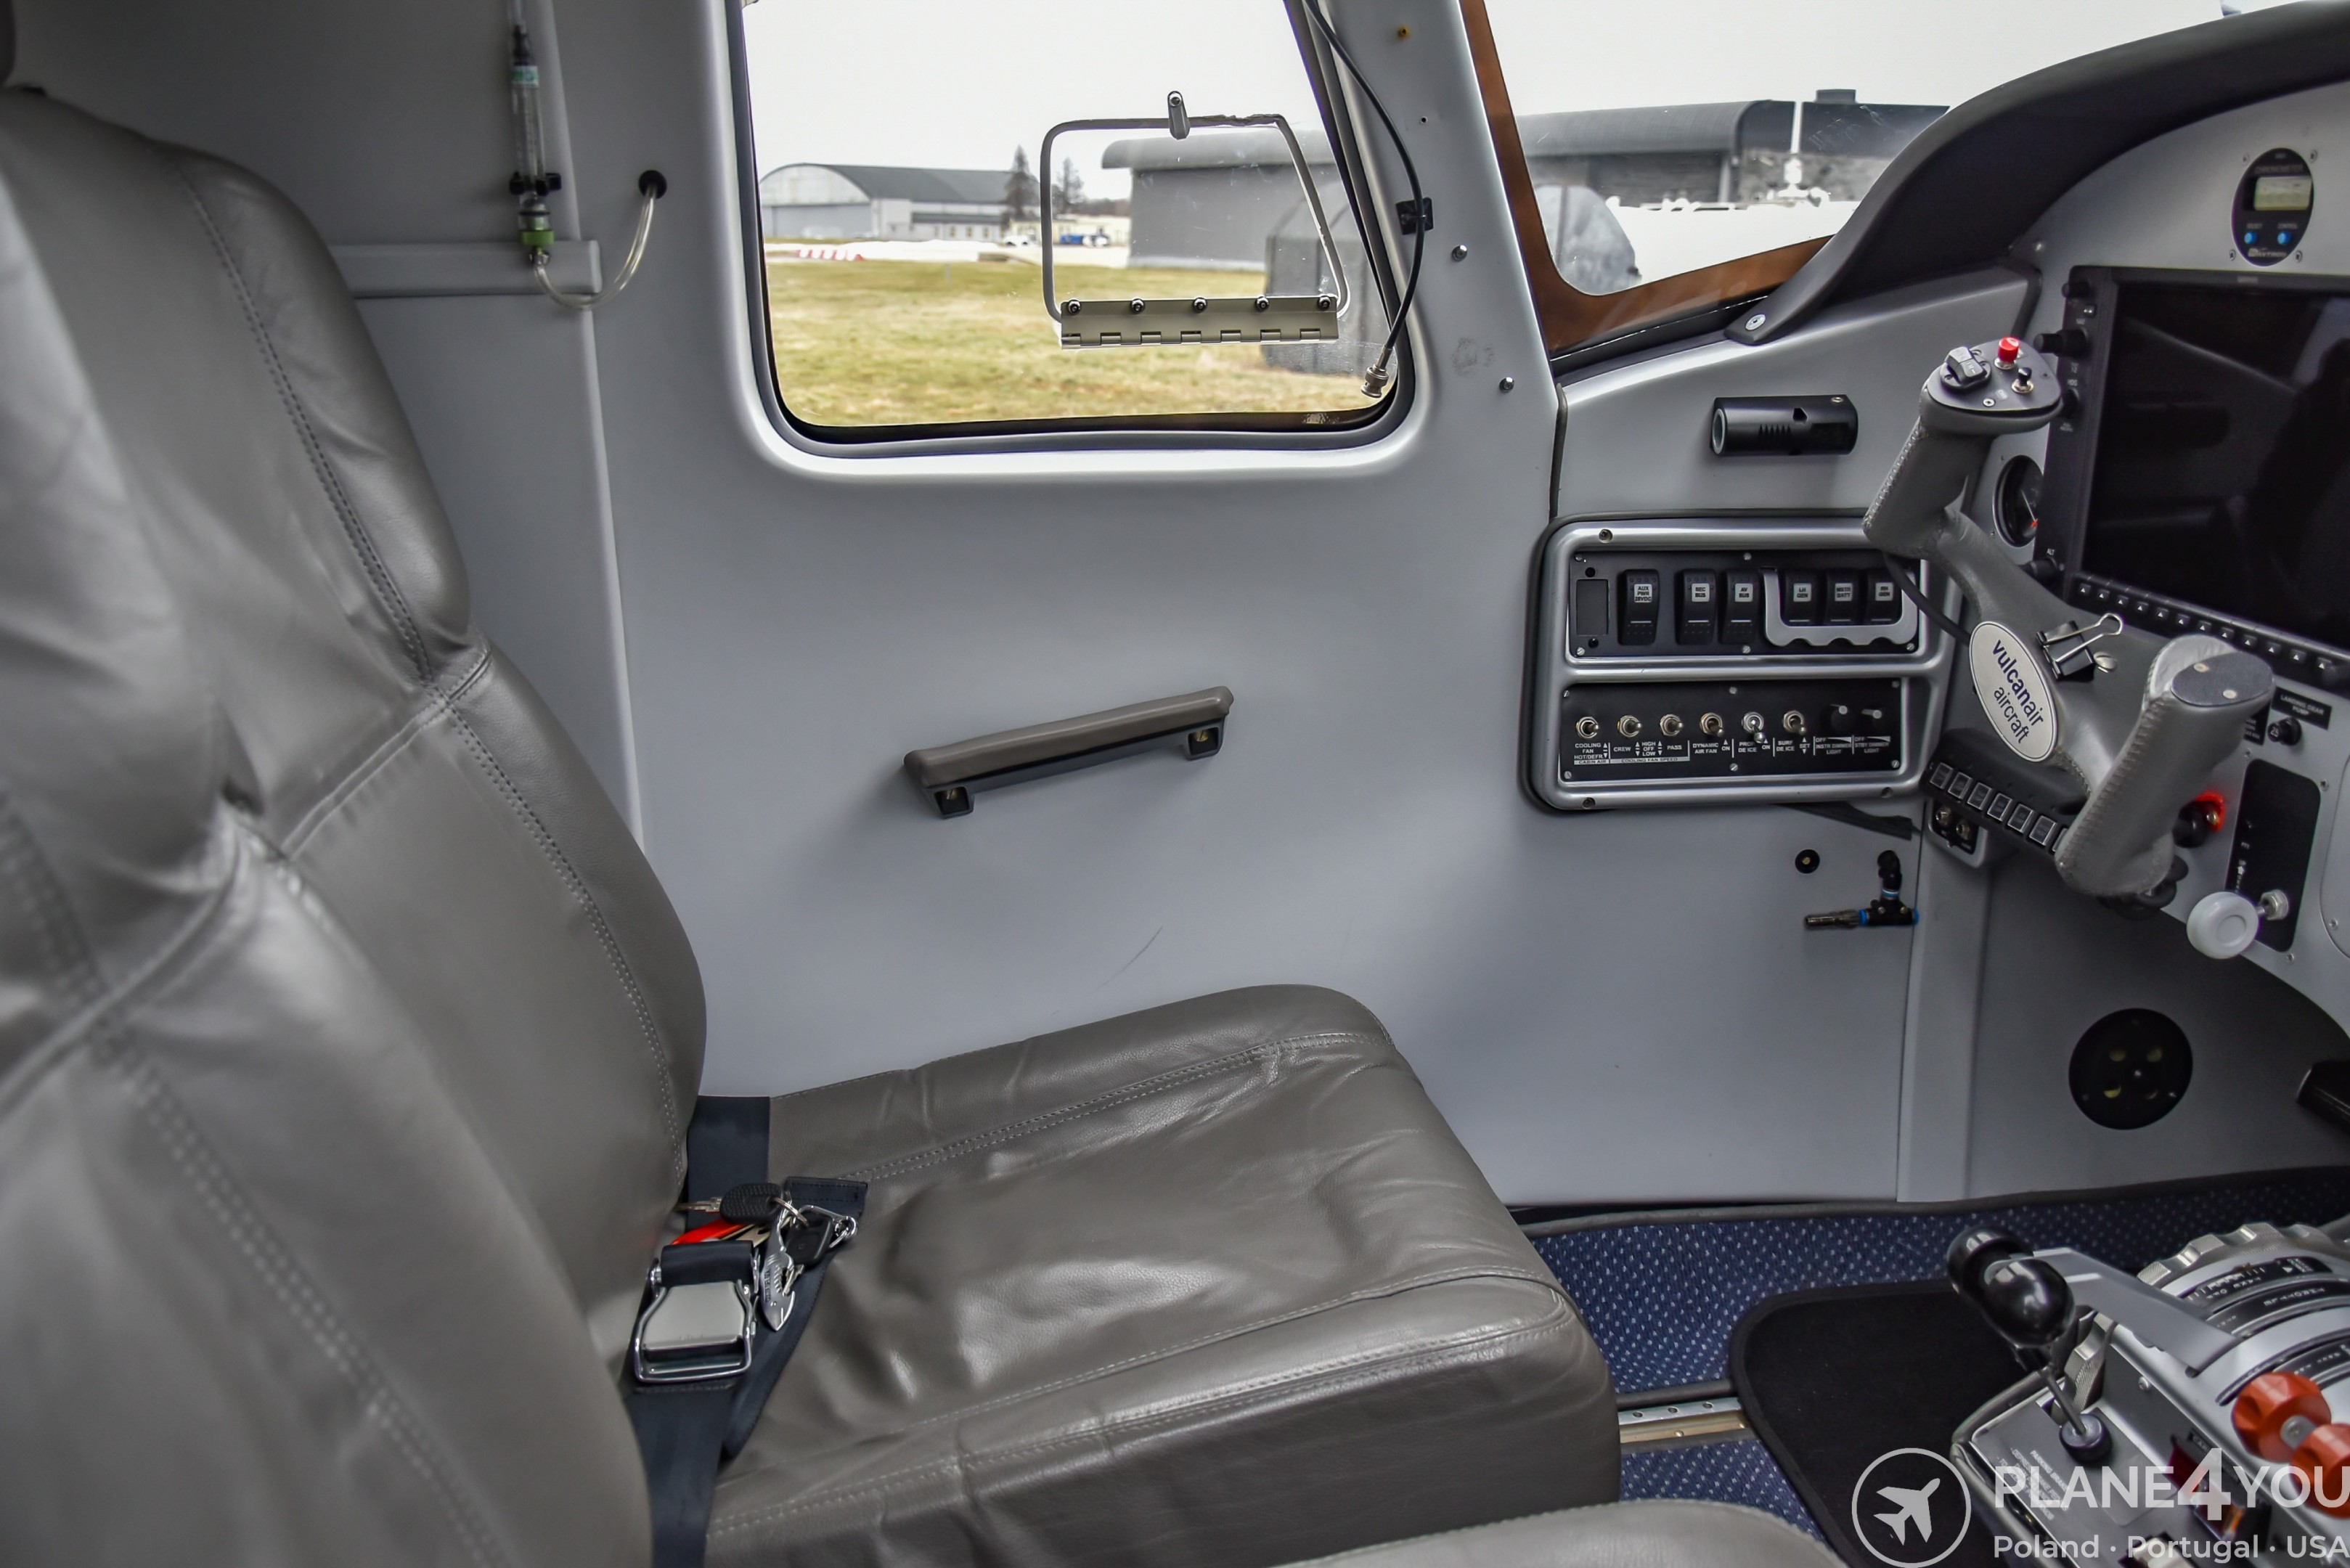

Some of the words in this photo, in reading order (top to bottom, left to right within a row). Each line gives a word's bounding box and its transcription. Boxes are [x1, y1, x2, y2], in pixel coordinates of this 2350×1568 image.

[1992, 640, 2044, 726] vulcanair
[1994, 687, 2030, 744] aircraft
[2280, 695, 2306, 708] LANDING
[2307, 704, 2325, 715] GEAR
[2030, 1450, 2053, 1474] PARKING
